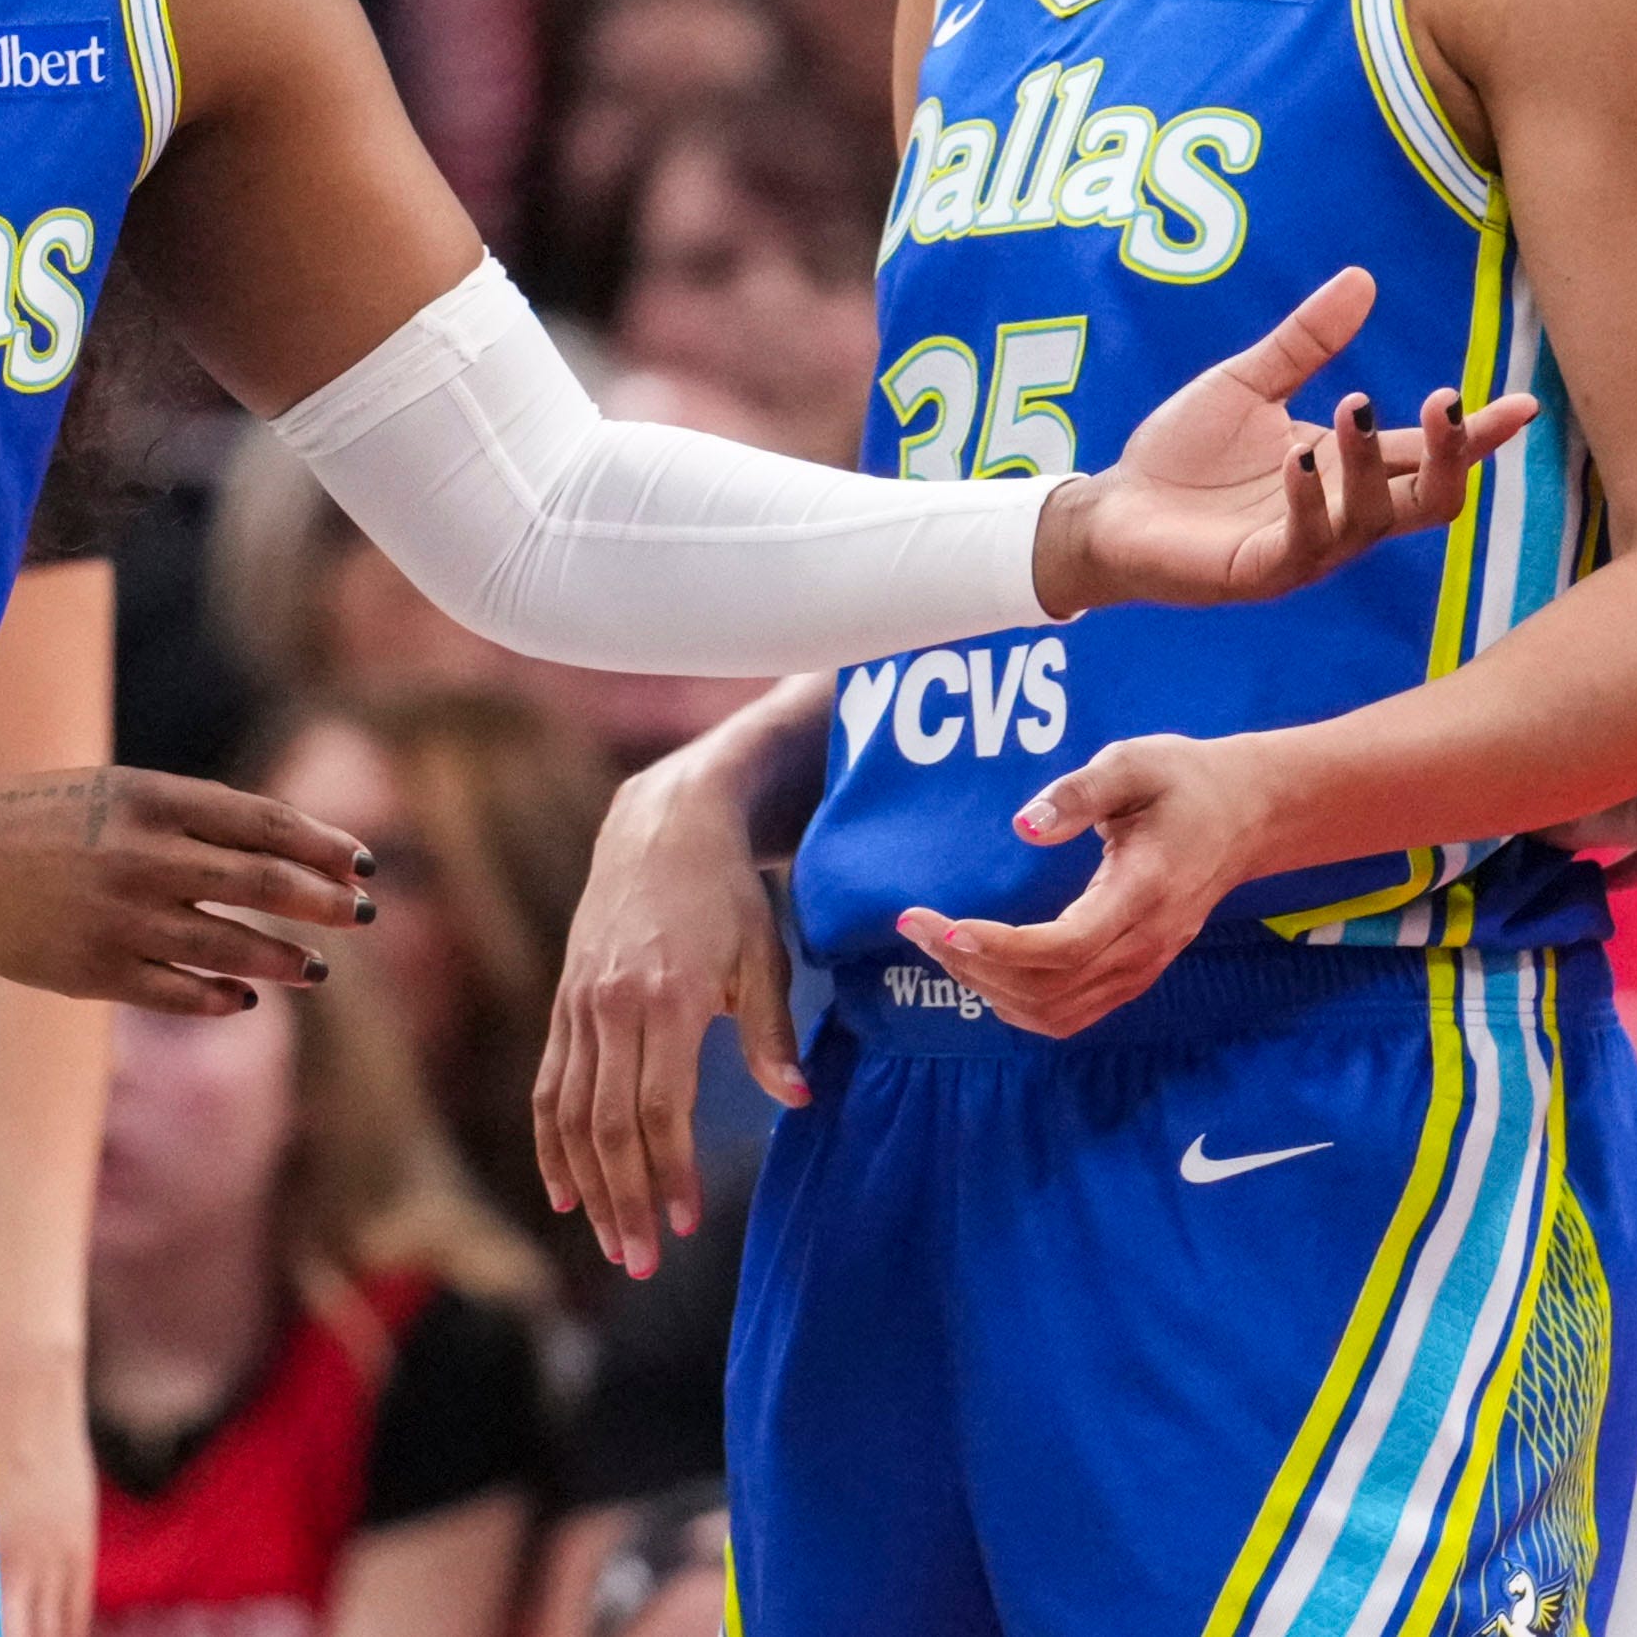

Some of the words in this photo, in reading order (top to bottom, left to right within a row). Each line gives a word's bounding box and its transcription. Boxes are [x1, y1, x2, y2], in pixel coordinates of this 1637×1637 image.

[880, 315, 1088, 481] 35
[894, 639, 1068, 765] CVS
[883, 965, 993, 1020] Wing
